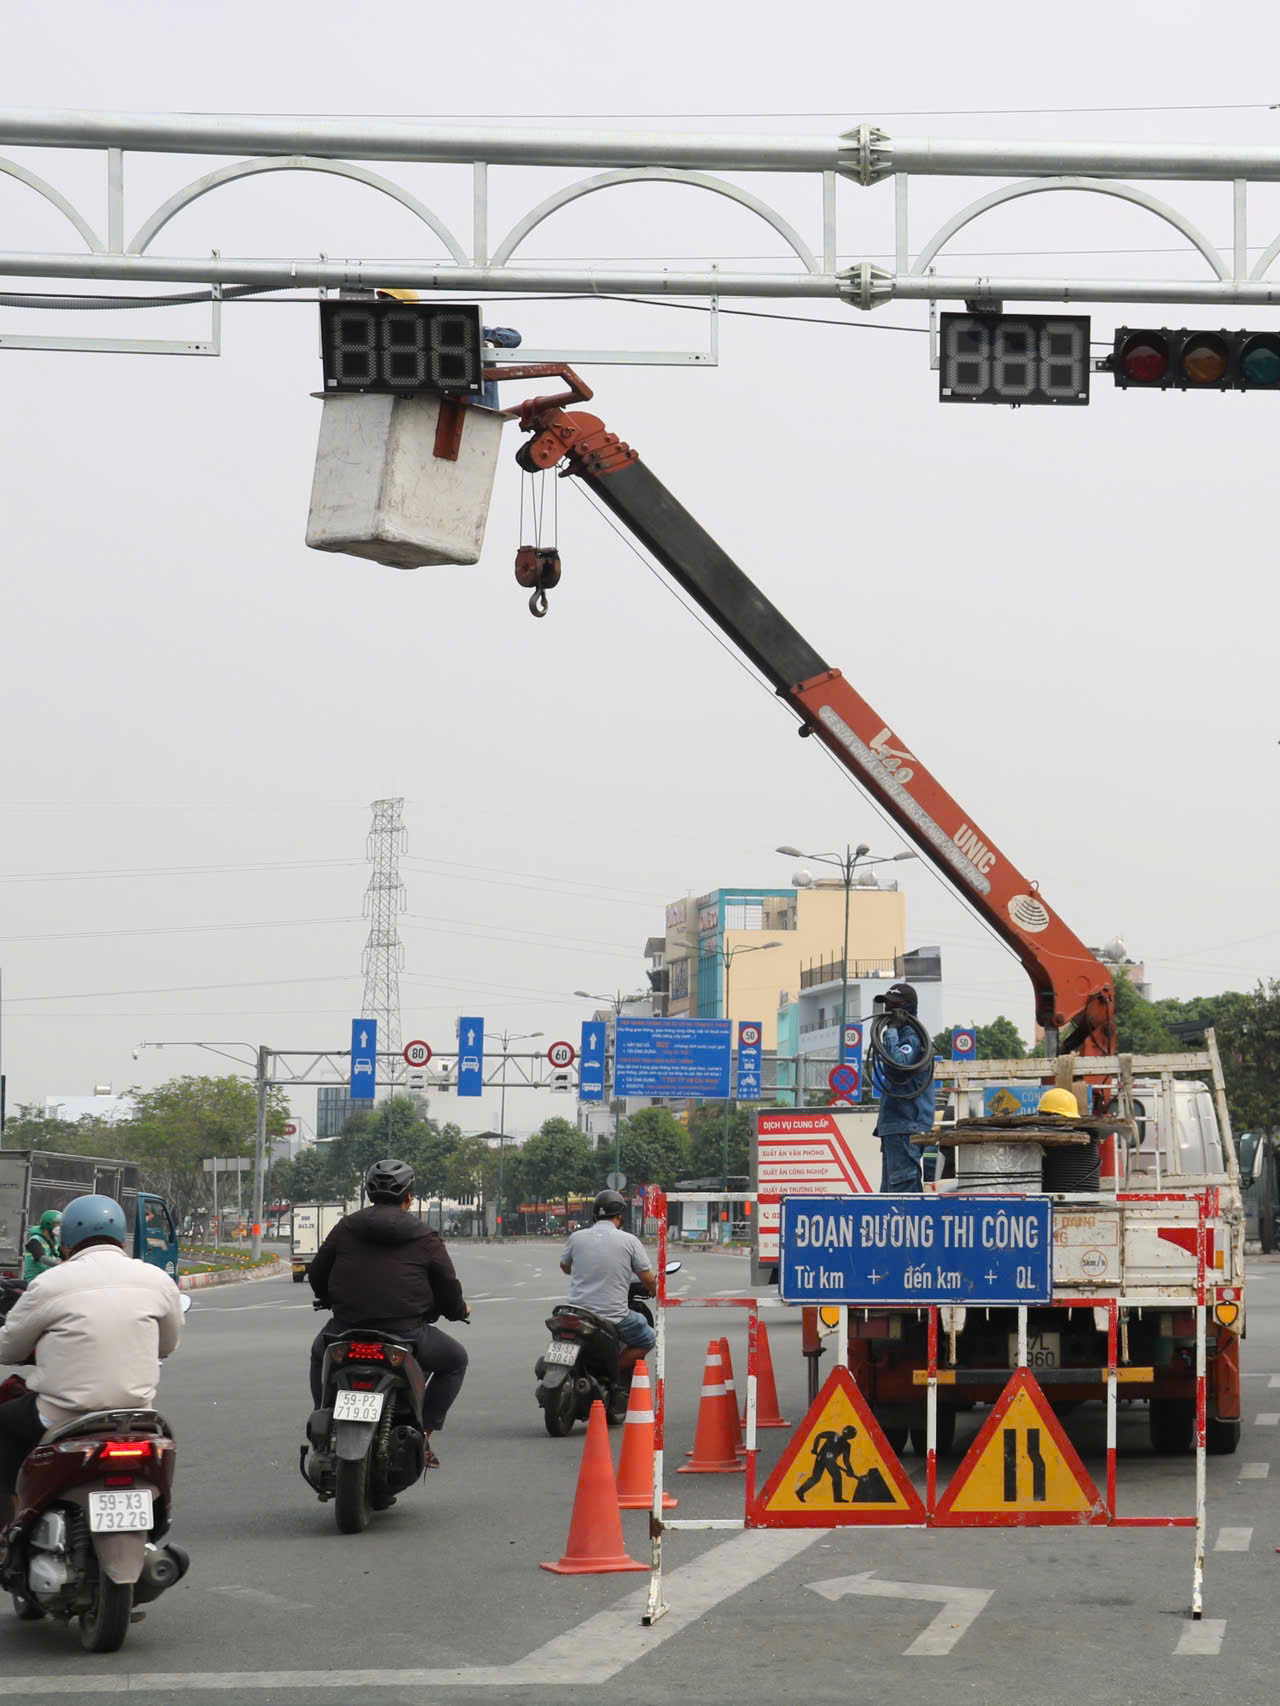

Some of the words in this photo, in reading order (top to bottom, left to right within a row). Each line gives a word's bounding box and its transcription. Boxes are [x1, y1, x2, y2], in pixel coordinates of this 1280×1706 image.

[953, 823, 996, 874] UNIC
[745, 1029, 755, 1040] 50
[846, 1032, 856, 1042] 50
[959, 1038, 969, 1048] 50
[412, 1049, 424, 1060] 80
[555, 1049, 567, 1061] 60
[763, 1121, 781, 1131] DỊCH
[781, 1121, 792, 1131] VỤ
[793, 1120, 813, 1129] CUNG
[814, 1118, 829, 1128] CẤP
[795, 1215, 853, 1253] ĐOẠN
[860, 1206, 934, 1248] ĐƯỜNG
[941, 1215, 974, 1248] THI
[981, 1209, 1038, 1248] CÔNG
[795, 1265, 815, 1289] Từ
[820, 1266, 844, 1289] km
[904, 1263, 932, 1289] đến
[937, 1266, 961, 1289] km
[1016, 1266, 1036, 1289] QL
[343, 1393, 377, 1408] 59-P2
[336, 1406, 378, 1420] 719.03
[99, 1493, 142, 1511] 59-X3
[96, 1511, 148, 1530] 732.26
